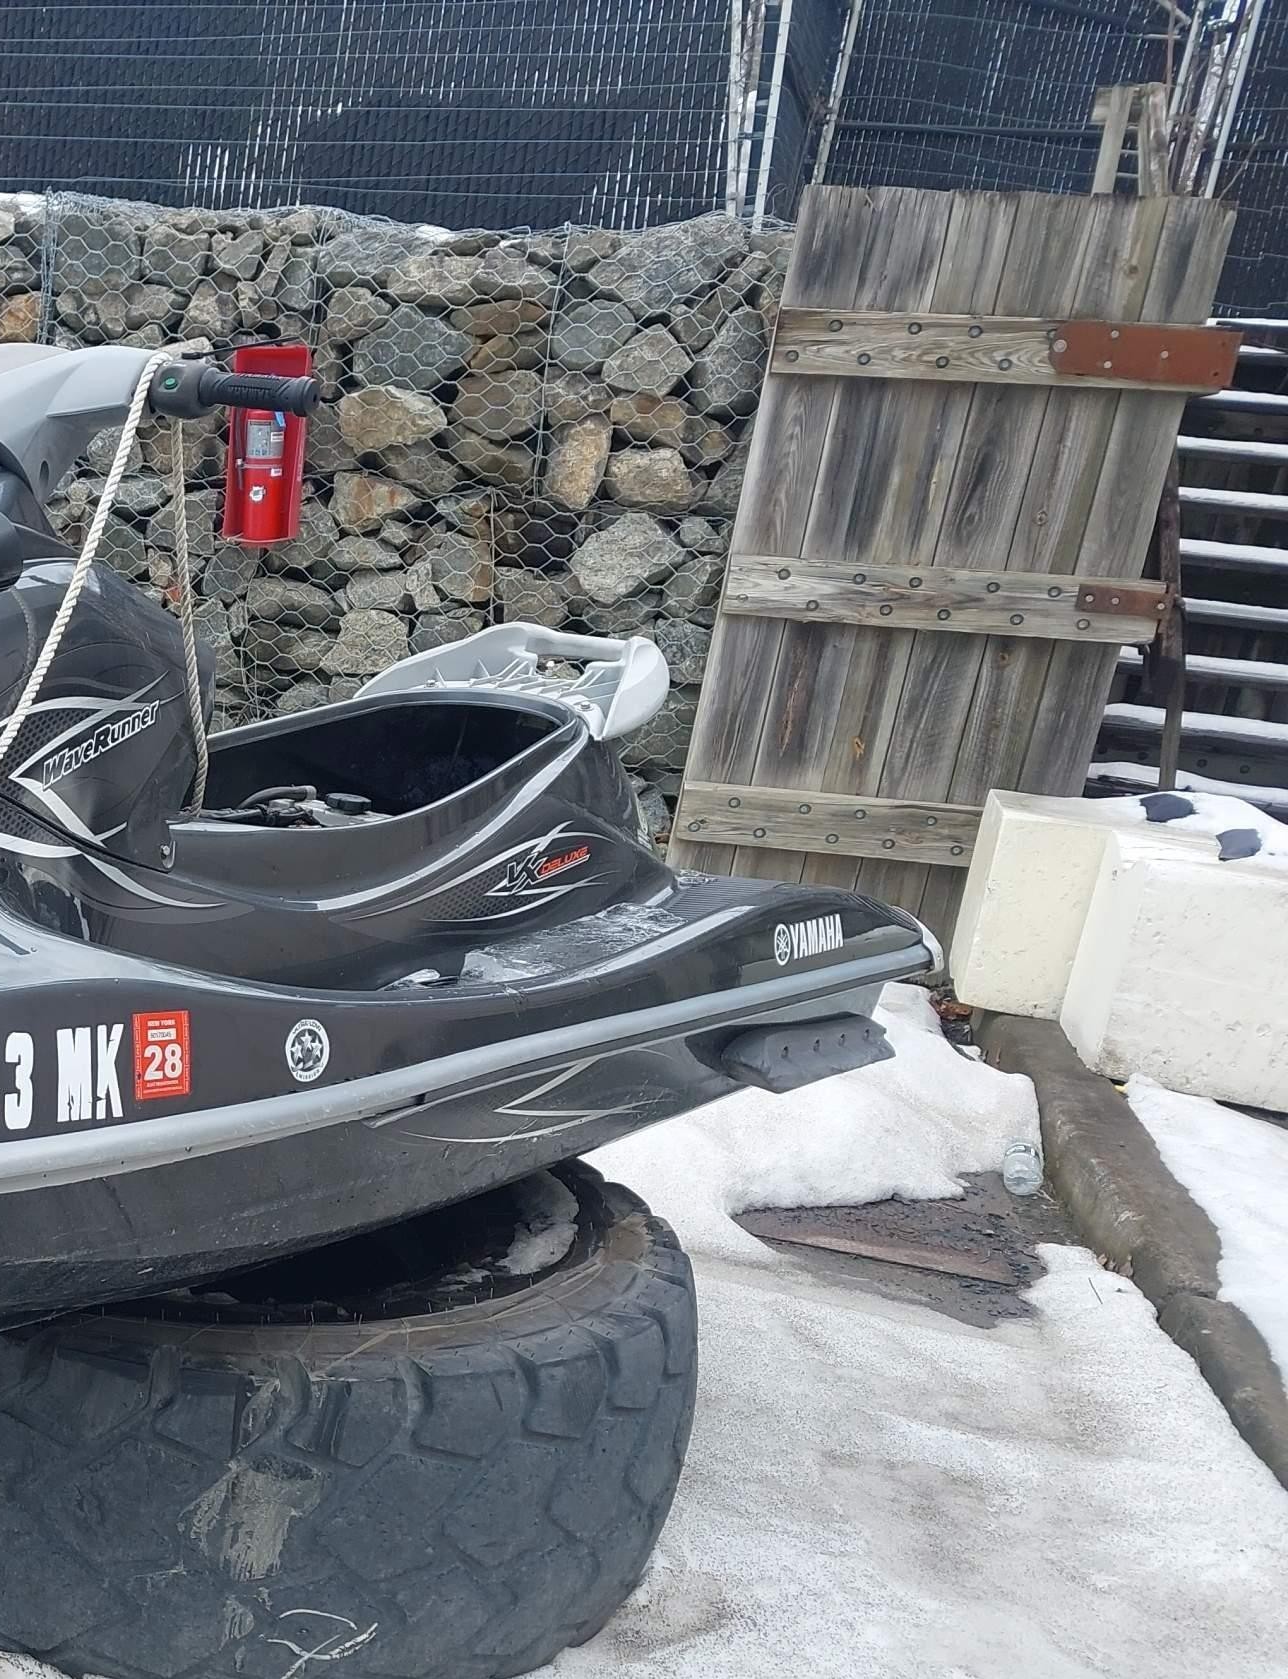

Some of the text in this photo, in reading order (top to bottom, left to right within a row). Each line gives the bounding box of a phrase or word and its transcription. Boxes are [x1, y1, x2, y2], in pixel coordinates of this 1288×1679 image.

[43, 700, 160, 792] WaveRunner
[540, 846, 589, 875] DELUXE
[789, 913, 844, 960] YAMAHA
[56, 1023, 125, 1123] MK
[143, 1043, 183, 1081] 28
